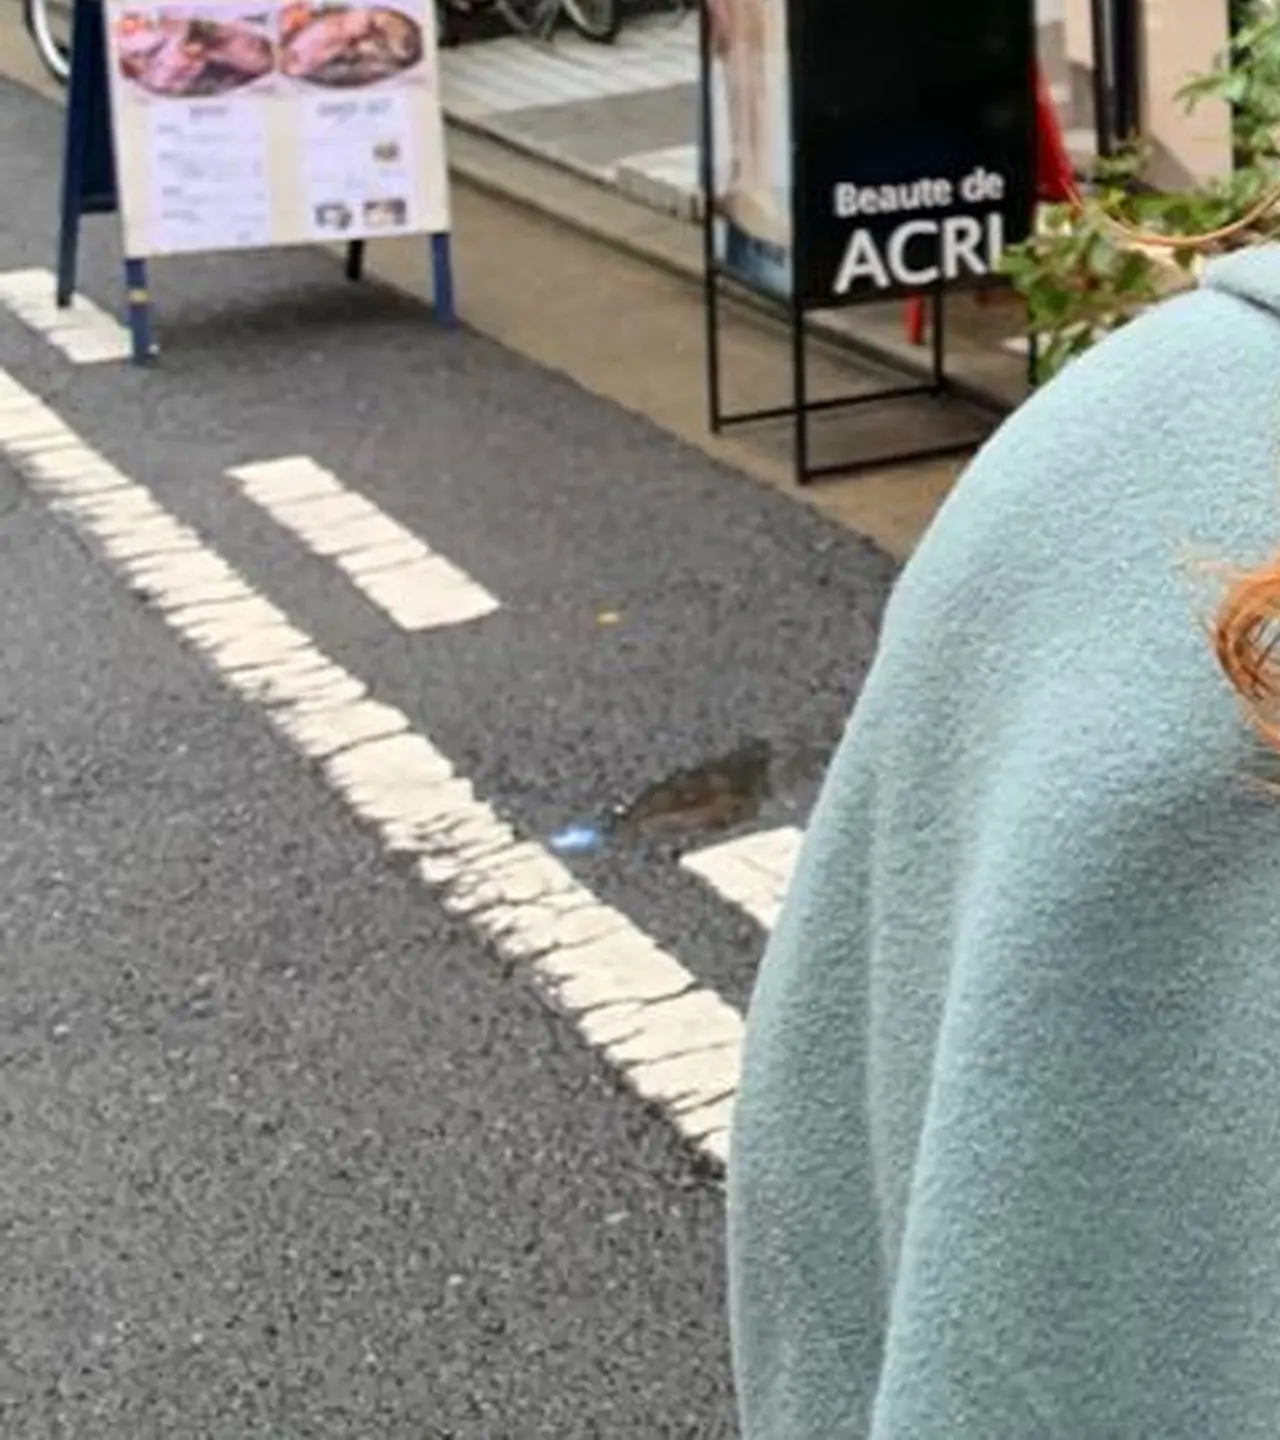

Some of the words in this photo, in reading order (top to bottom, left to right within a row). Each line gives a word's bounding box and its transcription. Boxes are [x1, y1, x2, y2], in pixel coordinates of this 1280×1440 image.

[834, 177, 953, 218] Beaute
[961, 165, 1004, 202] de
[833, 212, 1004, 295] ACRI
